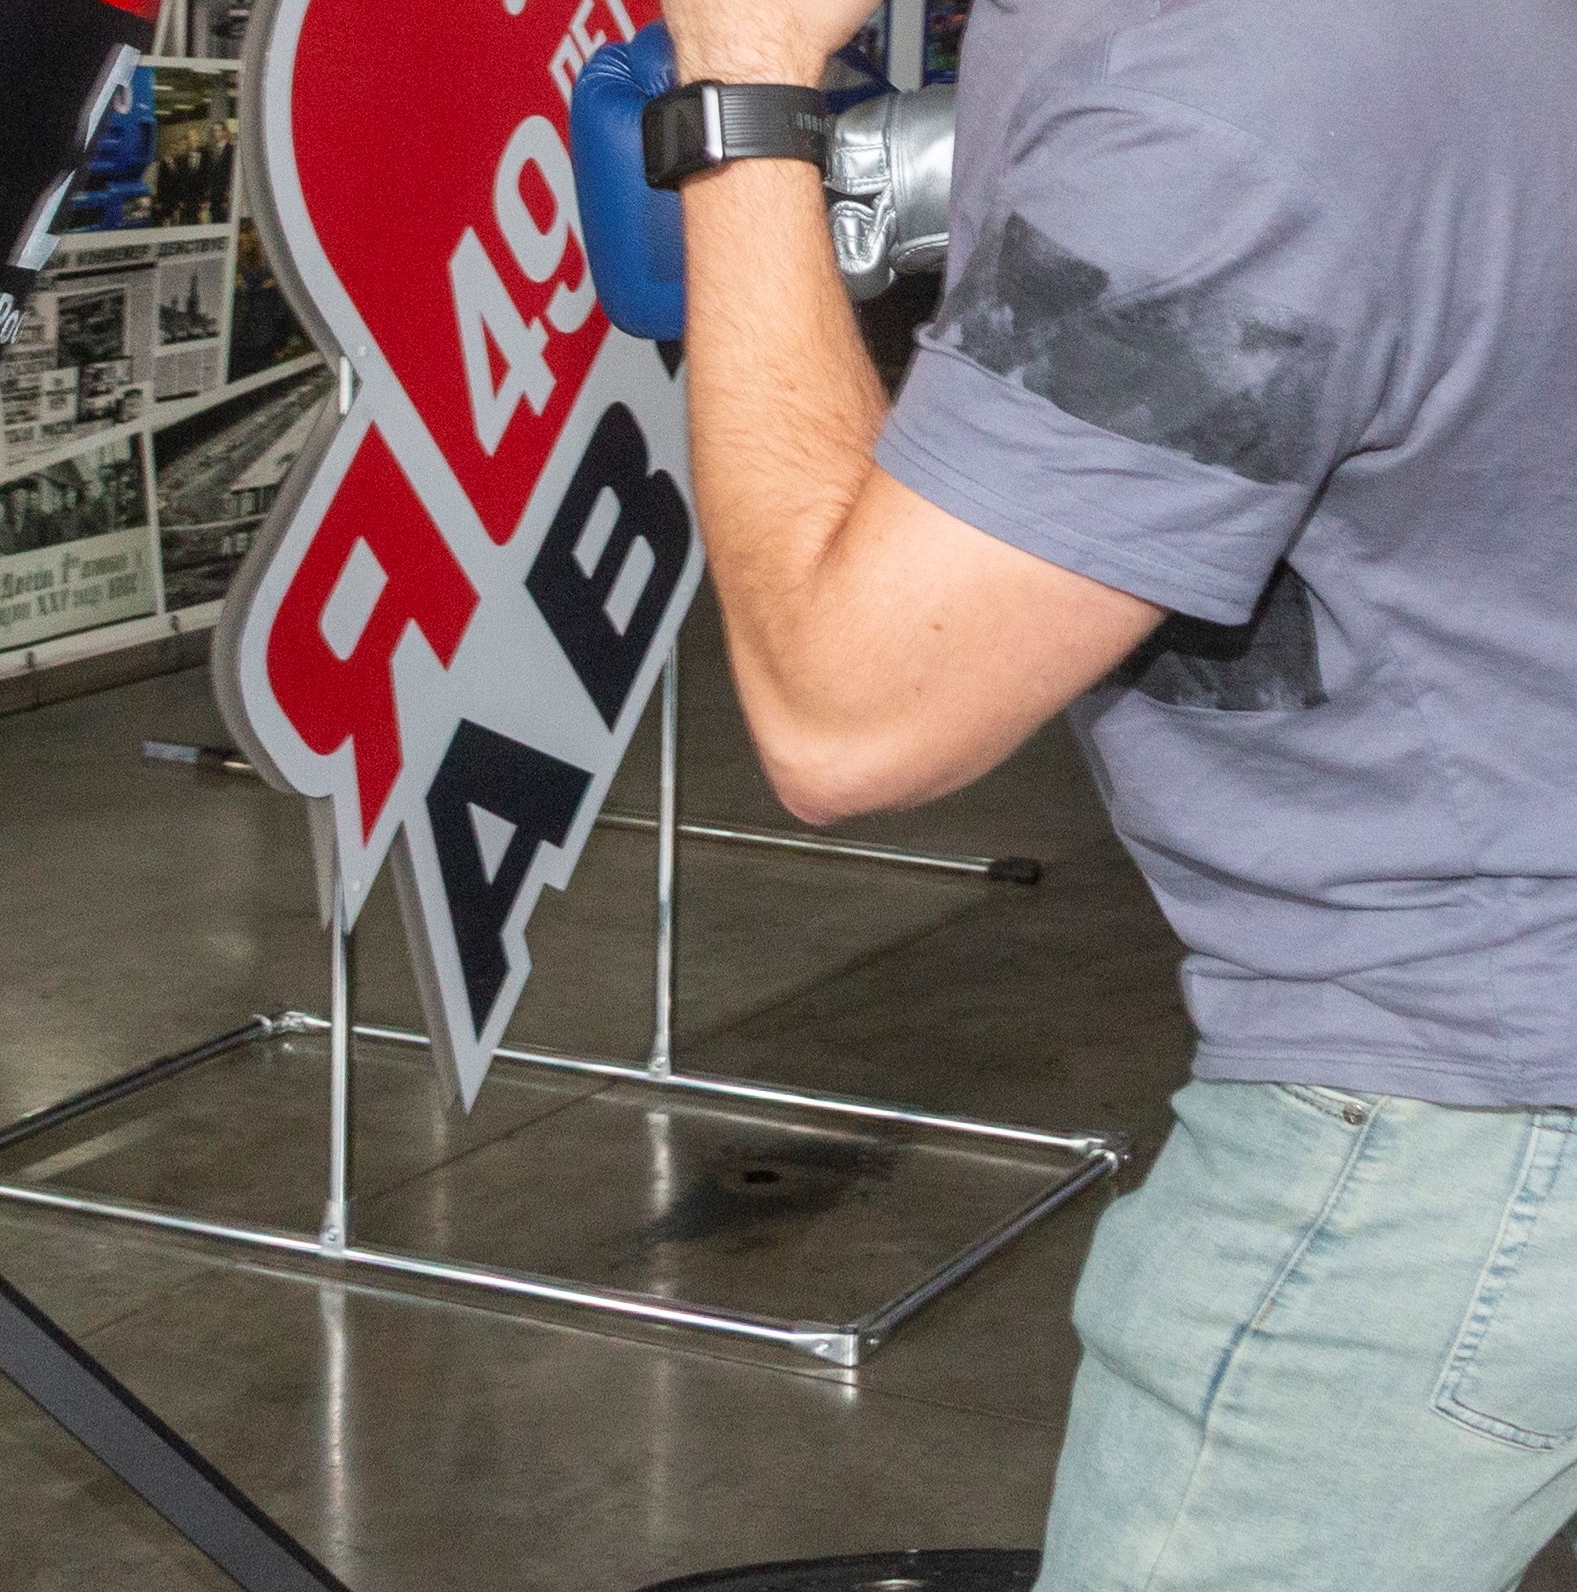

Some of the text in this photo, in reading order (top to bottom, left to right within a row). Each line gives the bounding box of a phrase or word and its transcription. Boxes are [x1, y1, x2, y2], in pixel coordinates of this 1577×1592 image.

[448, 114, 600, 457] 49
[267, 422, 480, 849] Я
[425, 339, 694, 1045] АВ
